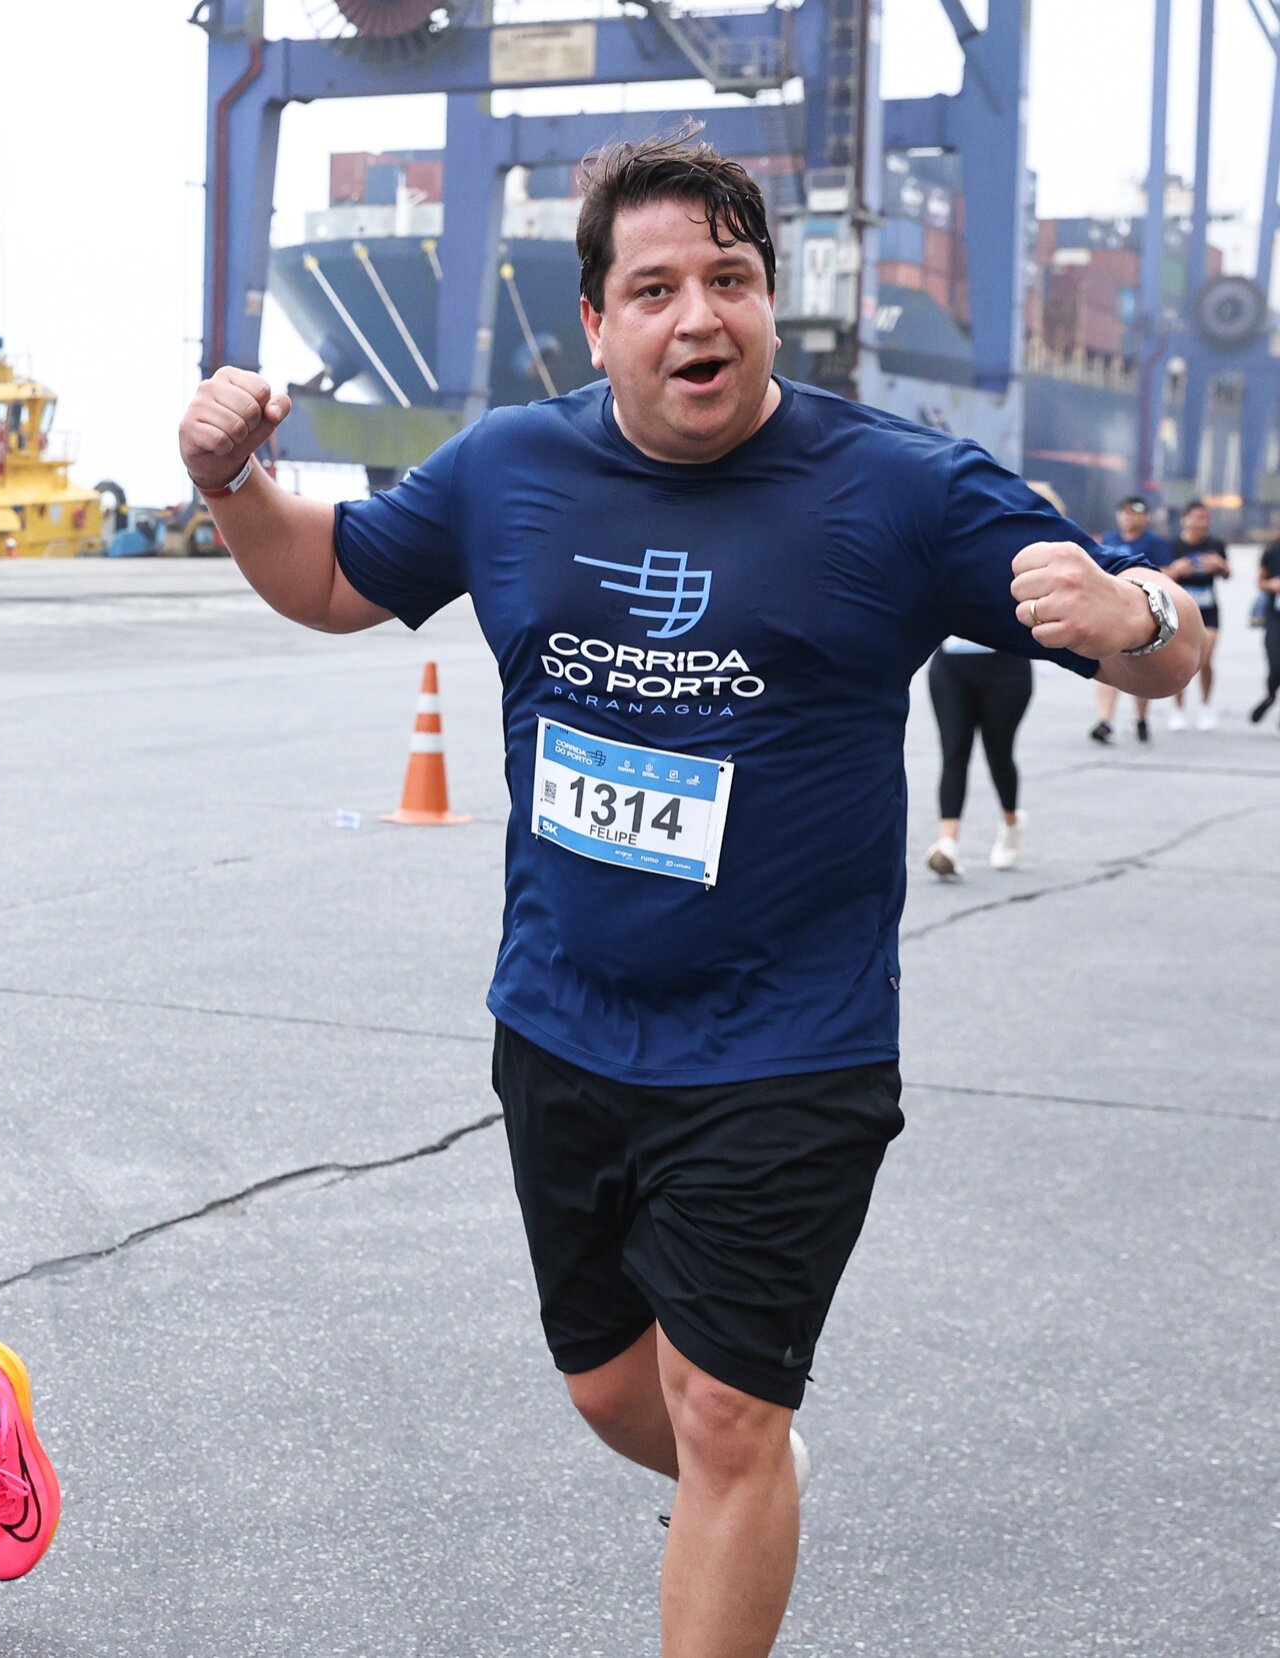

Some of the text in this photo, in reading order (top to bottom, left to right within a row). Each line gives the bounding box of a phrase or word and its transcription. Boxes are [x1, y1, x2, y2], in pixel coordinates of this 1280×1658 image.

[548, 632, 751, 673] CORRIDA
[540, 654, 765, 699] DO PORTO
[553, 686, 734, 717] PARANAGUÁ
[554, 745, 593, 765] DO PORTO
[555, 739, 587, 757] CORRIDA
[569, 775, 683, 841] 1314
[541, 819, 559, 837] 5K
[589, 824, 638, 846] FELIPE
[640, 855, 660, 864] rumo
